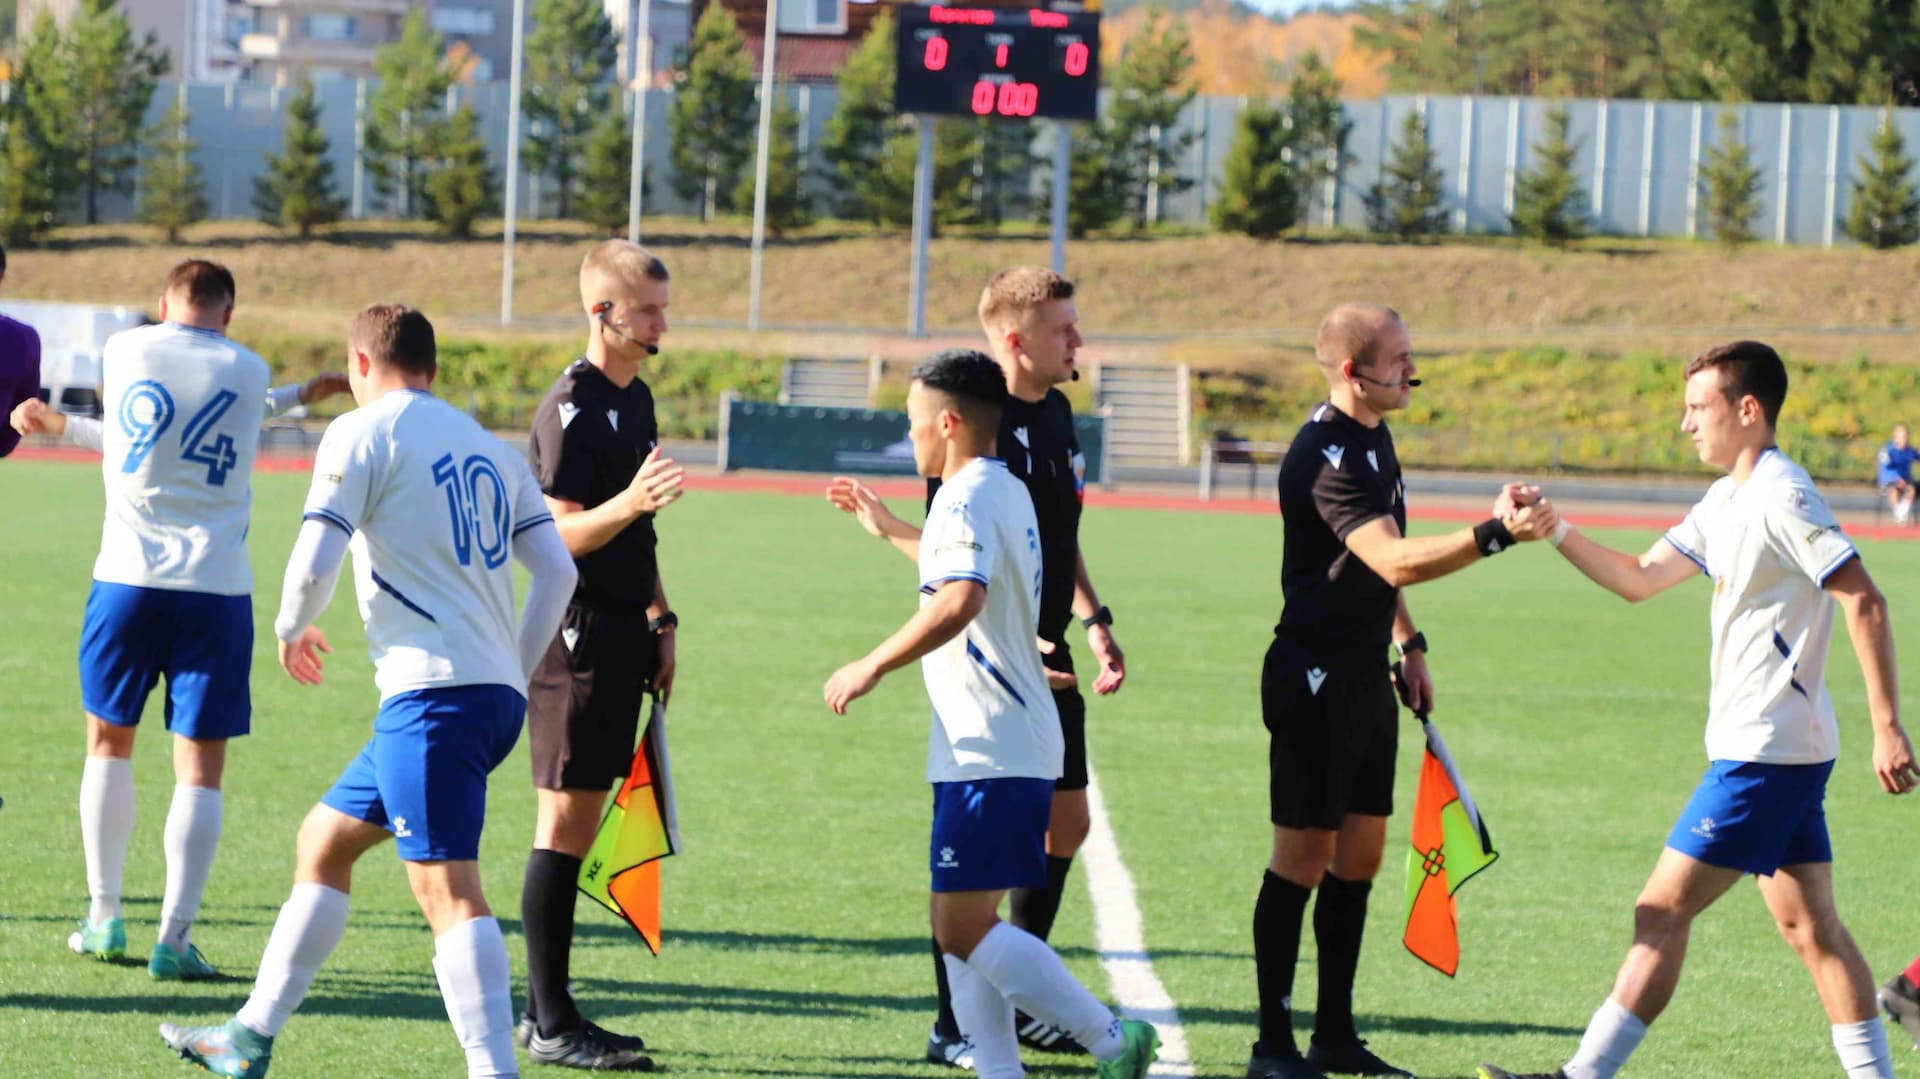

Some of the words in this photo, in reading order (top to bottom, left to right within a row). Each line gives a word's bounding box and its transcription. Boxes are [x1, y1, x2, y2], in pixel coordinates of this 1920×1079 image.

[924, 36, 948, 71] 0
[995, 43, 1008, 68] 1
[1064, 42, 1088, 77] 0
[119, 380, 238, 487] 94
[431, 452, 510, 570] 10
